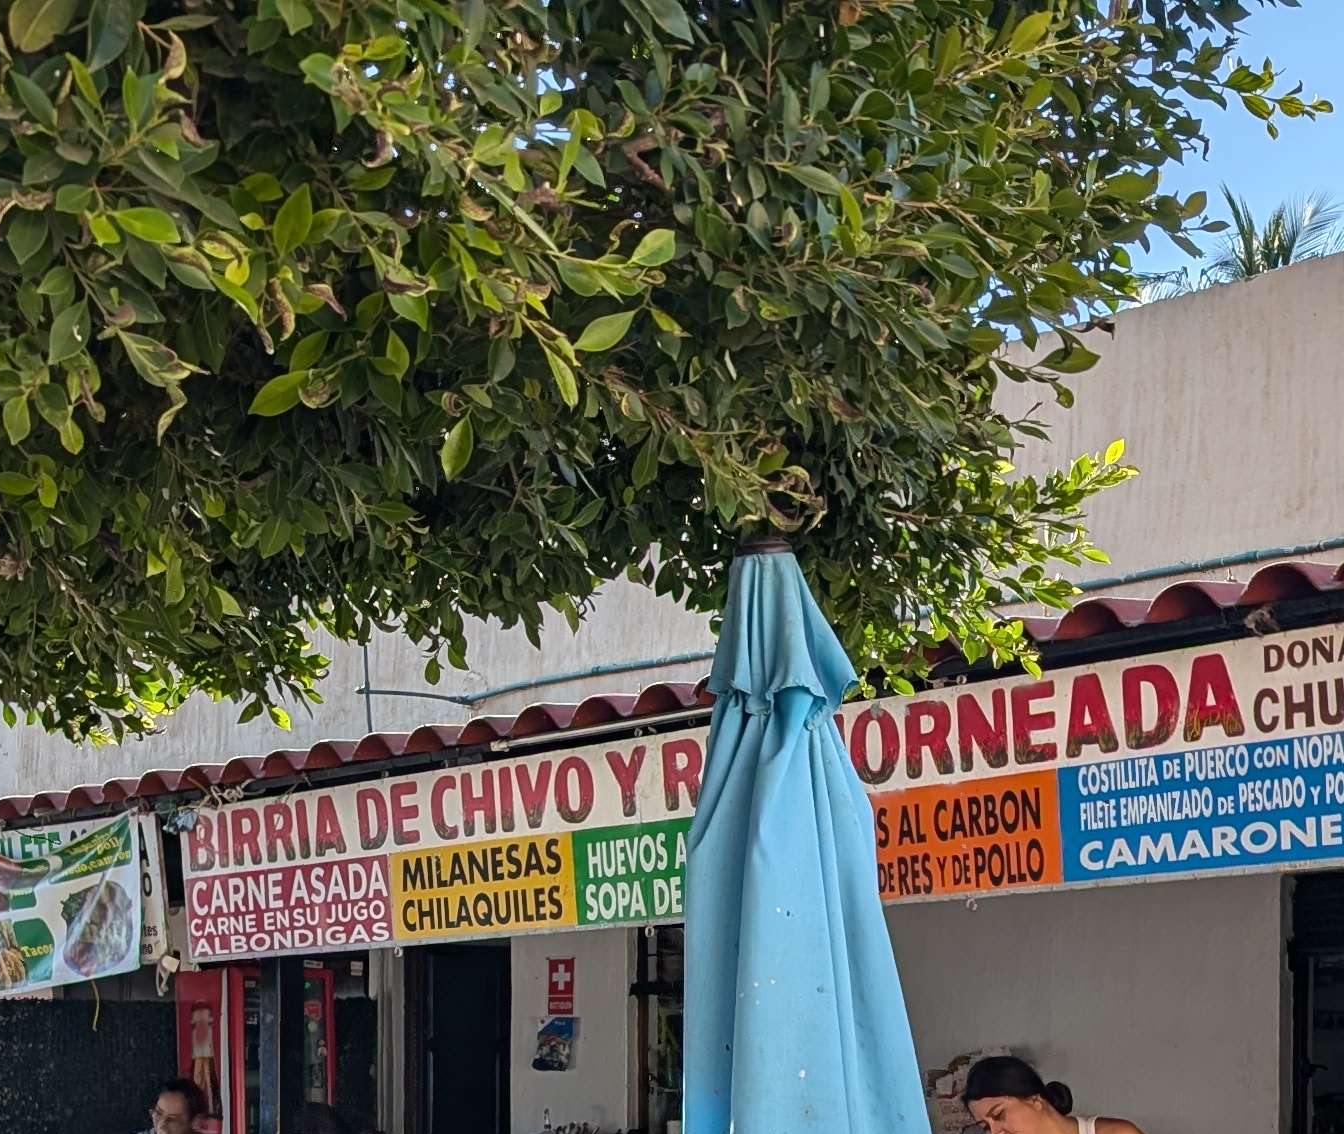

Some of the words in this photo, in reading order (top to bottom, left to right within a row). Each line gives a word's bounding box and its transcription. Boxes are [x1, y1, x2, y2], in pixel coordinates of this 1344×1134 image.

[1077, 761, 1159, 796] COSTILLITA
[1162, 760, 1182, 780] DE
[1185, 745, 1250, 782] PUERCO
[1254, 746, 1289, 770] CON
[187, 794, 347, 873] BIRRIA
[359, 780, 422, 851] DE
[430, 755, 595, 841] CHIVO
[605, 744, 647, 818] Y
[662, 735, 710, 811] R
[897, 803, 927, 846] AL
[933, 787, 1042, 841] CARBON
[1079, 799, 1117, 831] FILETE
[1120, 787, 1214, 827] EMPANIZADO
[1217, 796, 1236, 816] DE
[1238, 776, 1307, 813] PESCADO
[1309, 785, 1321, 806] Y
[401, 838, 562, 893] MILANESAS
[586, 836, 671, 879] HUEVOS
[674, 831, 691, 870] A
[897, 853, 934, 896] RES
[936, 856, 947, 889] Y
[951, 855, 972, 887] DE
[973, 838, 1045, 888] POLLO
[191, 872, 284, 916] CARNE
[289, 861, 389, 906] ASADA
[401, 885, 564, 932] CHILAQUILES
[585, 878, 648, 923] SOPA
[653, 876, 683, 916] DE
[189, 910, 259, 938] CARNE
[262, 908, 289, 929] EN
[293, 905, 320, 925] SU
[323, 899, 387, 924] JUGO
[193, 920, 390, 957] ALBONDIGAS
[20, 943, 54, 958] Tacos
